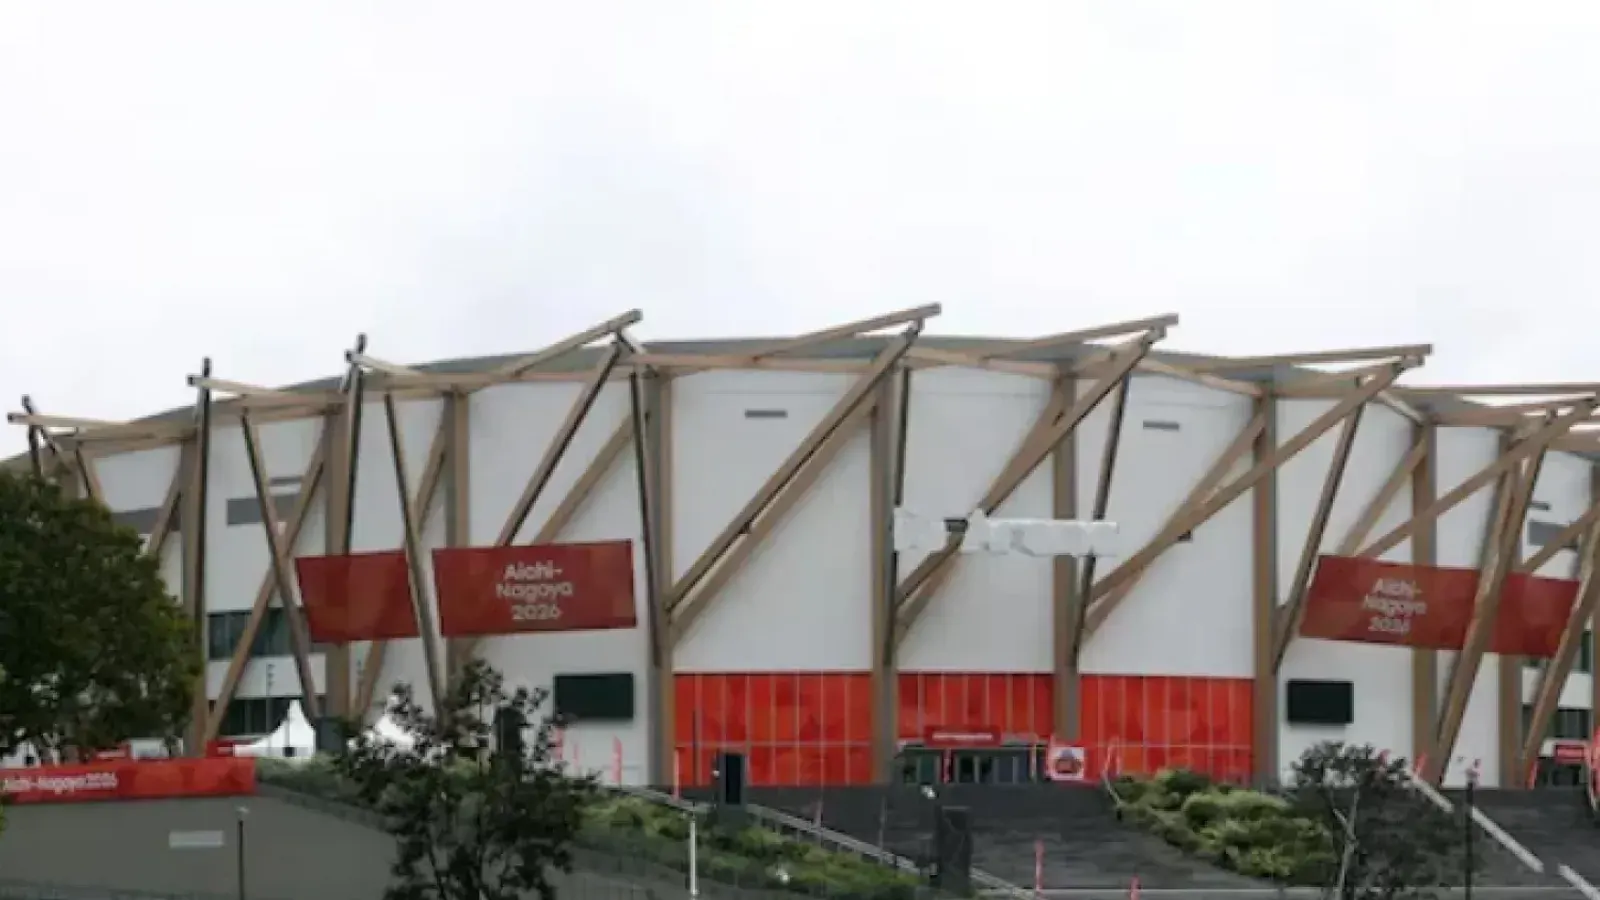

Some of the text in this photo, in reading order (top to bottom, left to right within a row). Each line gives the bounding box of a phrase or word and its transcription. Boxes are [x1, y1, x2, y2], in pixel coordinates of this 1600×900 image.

[503, 561, 562, 580] Aichi-
[496, 582, 573, 602] Nagoya
[511, 604, 562, 620] 2026
